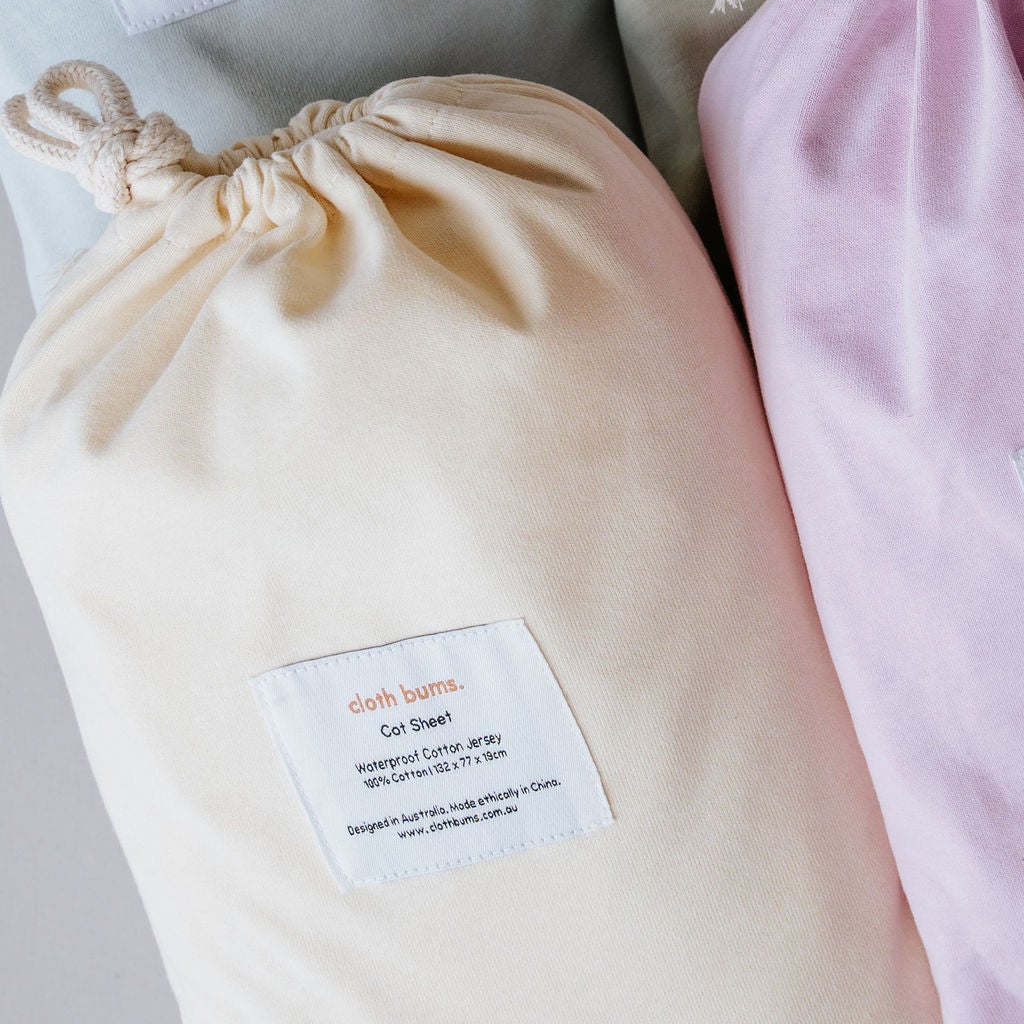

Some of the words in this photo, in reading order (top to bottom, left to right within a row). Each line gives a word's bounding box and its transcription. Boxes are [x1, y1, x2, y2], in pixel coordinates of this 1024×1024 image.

[348, 687, 398, 714] cloth
[399, 678, 464, 704] bums.
[380, 721, 407, 738] Cot
[409, 710, 452, 732] Sheet
[354, 749, 420, 774] Waterproof
[421, 742, 464, 760] Cotton
[466, 733, 501, 750] Jersey
[363, 775, 391, 789] 100%
[391, 768, 429, 783] Cotton
[432, 761, 451, 774] 132
[451, 761, 460, 770] x
[458, 755, 471, 767] 77
[473, 756, 482, 764] x
[481, 749, 508, 762] 19cm
[346, 817, 390, 836] Designed
[388, 815, 400, 825] in
[401, 805, 449, 824] Australia.
[449, 798, 477, 812] Made
[477, 787, 519, 806] ethically
[519, 784, 530, 794] in
[529, 778, 561, 792] China.
